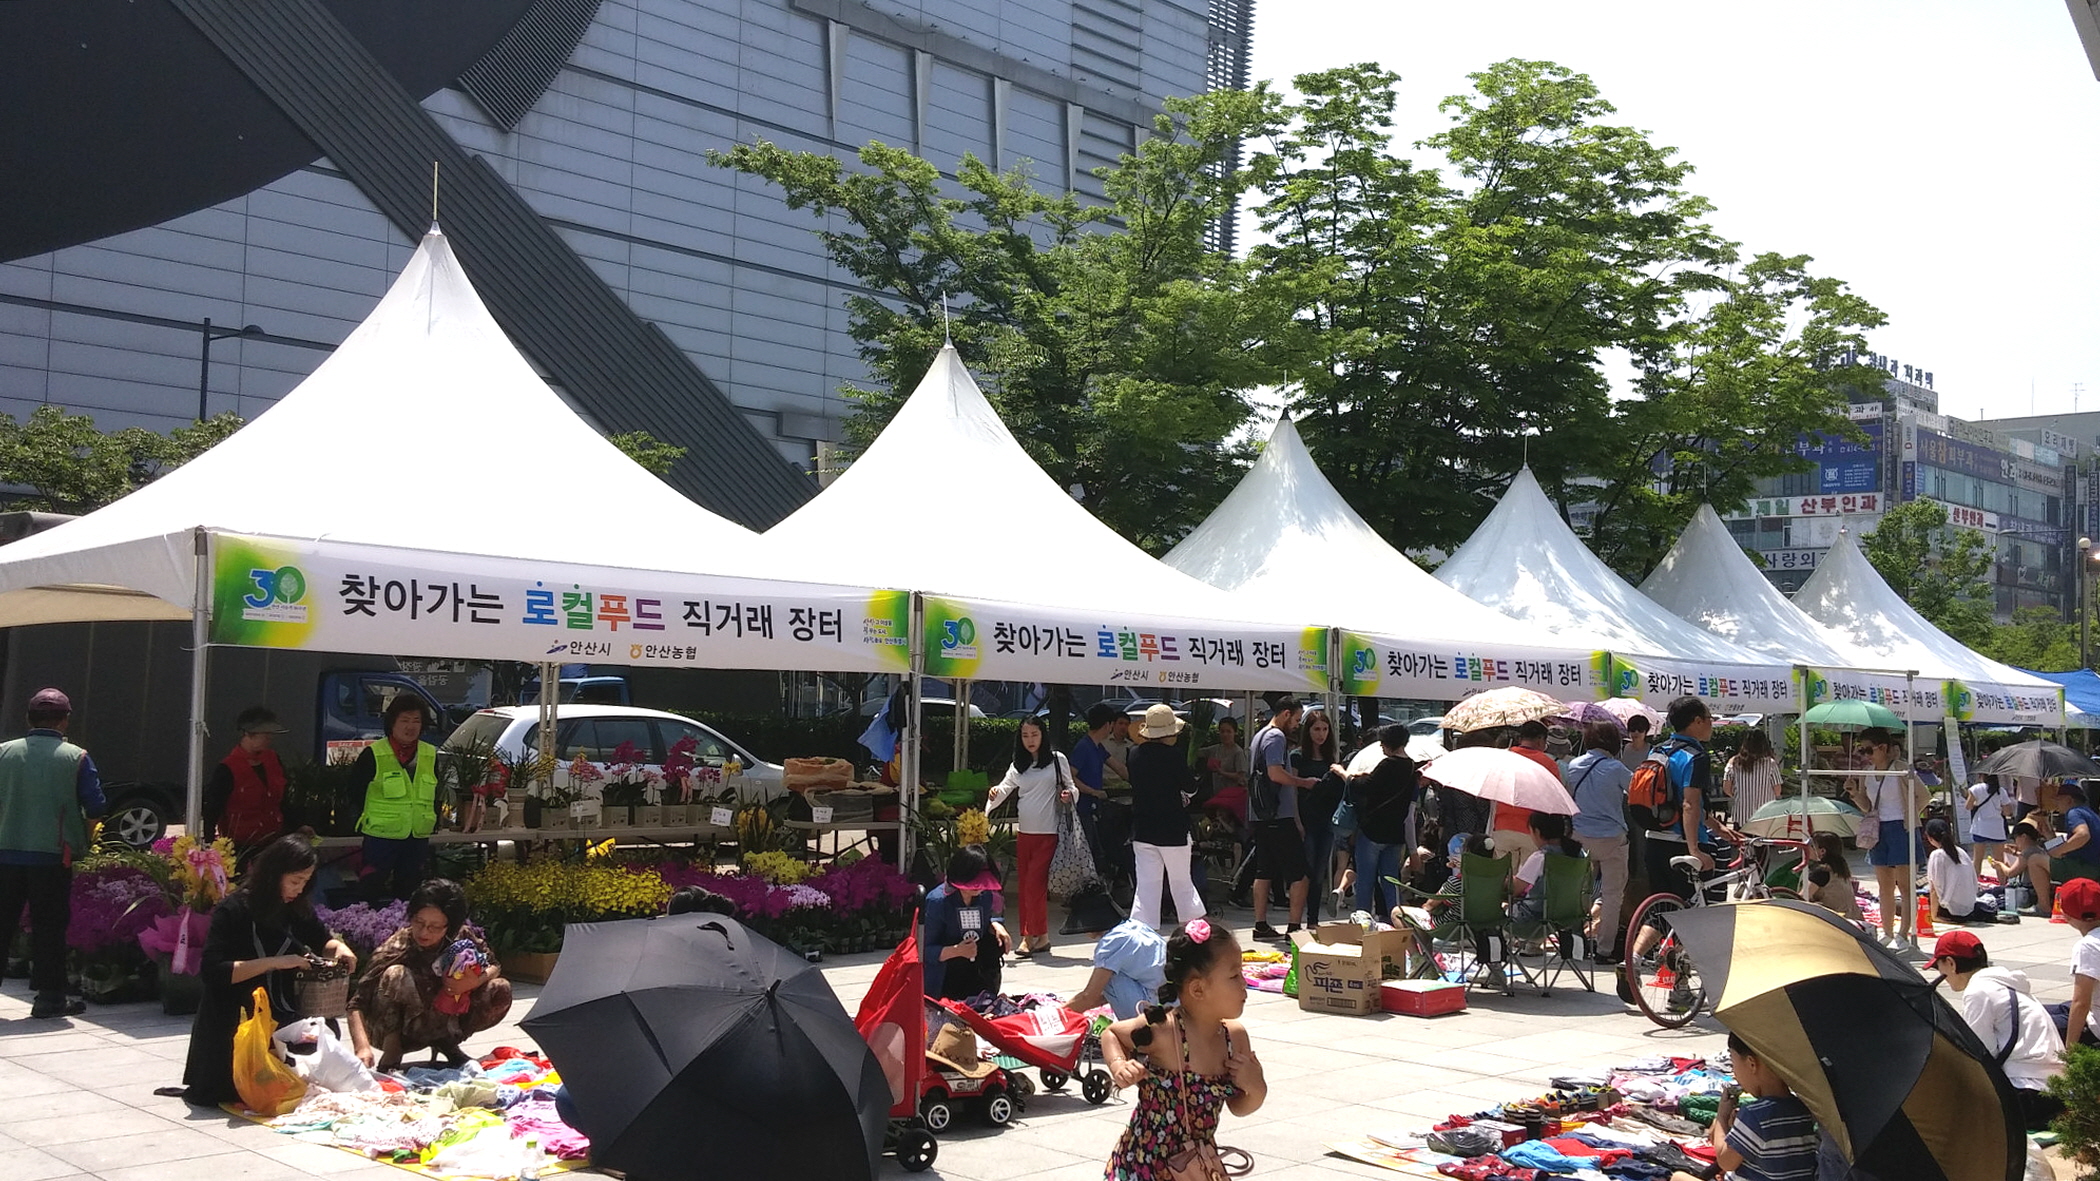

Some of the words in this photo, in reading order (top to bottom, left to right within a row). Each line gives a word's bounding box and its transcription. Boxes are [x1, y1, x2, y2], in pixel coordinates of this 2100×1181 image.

[1801, 495, 1878, 514] 산부인과
[1953, 507, 1984, 528] 산부인과
[1764, 551, 1826, 568] 사랑외
[339, 573, 504, 624] 찾아가는
[522, 581, 665, 632] 로컬푸드
[682, 600, 773, 640] 직거래
[788, 607, 842, 643] 장터
[570, 641, 612, 657] 안산시
[645, 644, 697, 660] 안산농협
[993, 621, 1087, 658] 찾아가는
[1097, 624, 1180, 662] 로컬푸드
[1188, 636, 1244, 667] 직거래
[1252, 641, 1286, 669] 장터
[1124, 669, 1149, 681] 안산시
[1168, 671, 1200, 683] 안산농협
[1387, 651, 1448, 679] 찾아가는
[1454, 652, 1510, 682] 로컬푸드
[1515, 660, 1553, 685] 직거래
[1558, 663, 1582, 686] 장터
[1648, 672, 1694, 696] 찾아가는
[1698, 673, 1738, 698] 로컬푸드
[1742, 680, 1768, 699] 직거래
[1771, 680, 1788, 699] 장터
[1833, 682, 1867, 700] 찾아가는
[1869, 683, 1900, 706] 로컬푸드
[1925, 691, 1938, 708] 장터
[1976, 692, 2005, 710] 찾아가는
[2004, 693, 2031, 711] 로컬푸드
[2029, 697, 2047, 712] 직거래
[1313, 976, 1344, 994] 피죤
